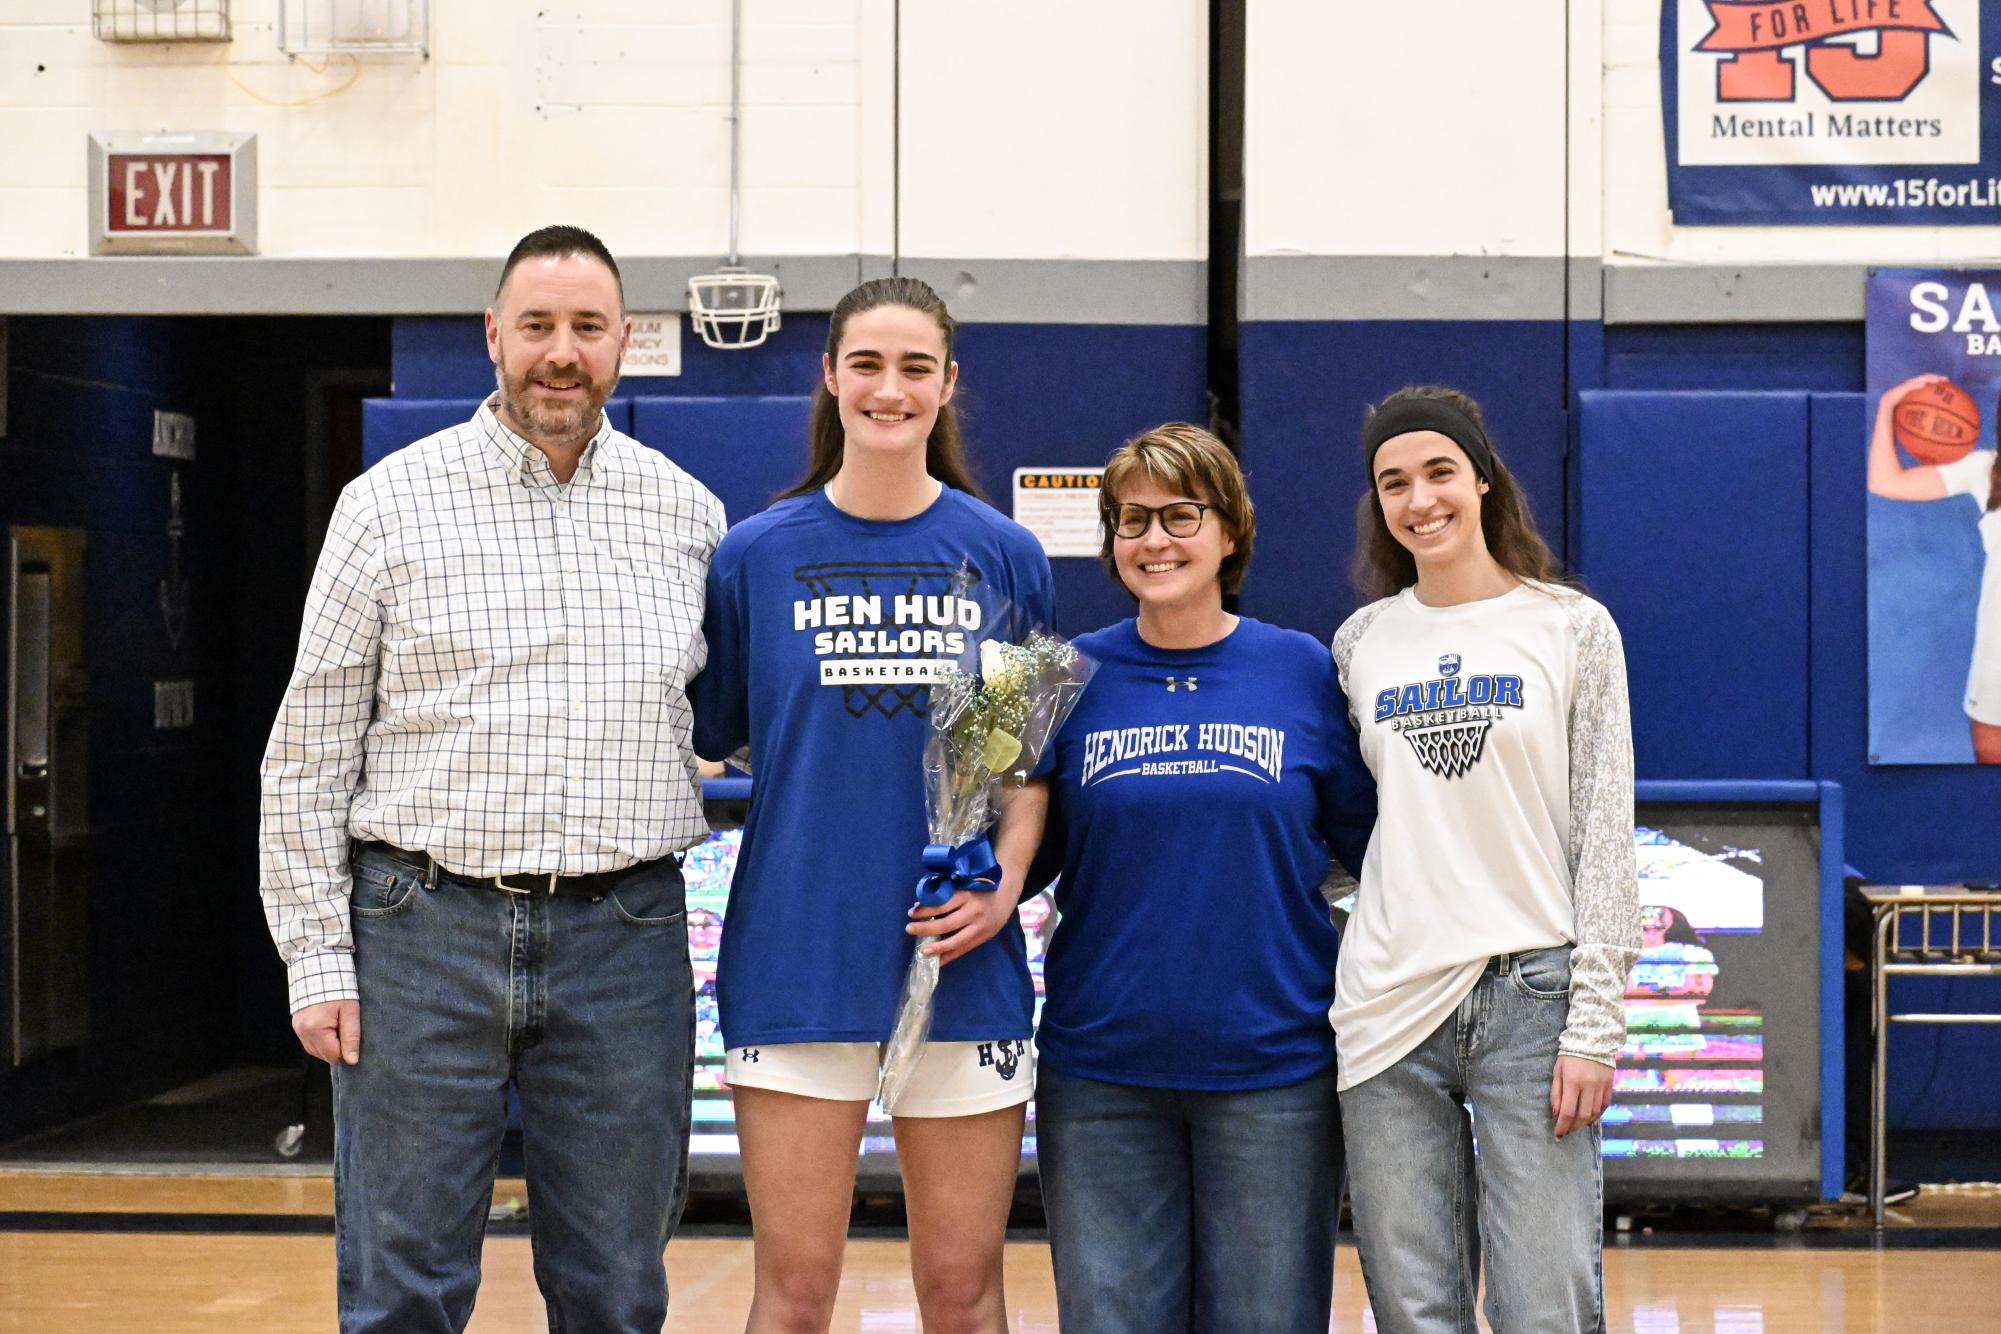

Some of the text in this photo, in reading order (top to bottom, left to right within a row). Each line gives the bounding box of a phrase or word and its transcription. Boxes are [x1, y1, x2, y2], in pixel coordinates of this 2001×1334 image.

[1750, 0, 1901, 42] FOR LIFE
[1711, 112, 1942, 139] Mental Matters
[125, 161, 220, 226] EXIT
[1909, 281, 2001, 333] SA
[1024, 474, 1100, 488] CAUTIO
[794, 594, 982, 631] HEN HUD
[815, 630, 965, 655] SAILORS
[825, 666, 946, 678] BASKETBAL
[1375, 674, 1523, 723] SAILOR
[1391, 706, 1503, 731] BASKETBALL
[1081, 723, 1285, 787] HENDRICK HUDSON
[1141, 760, 1219, 776] BASKETBALL
